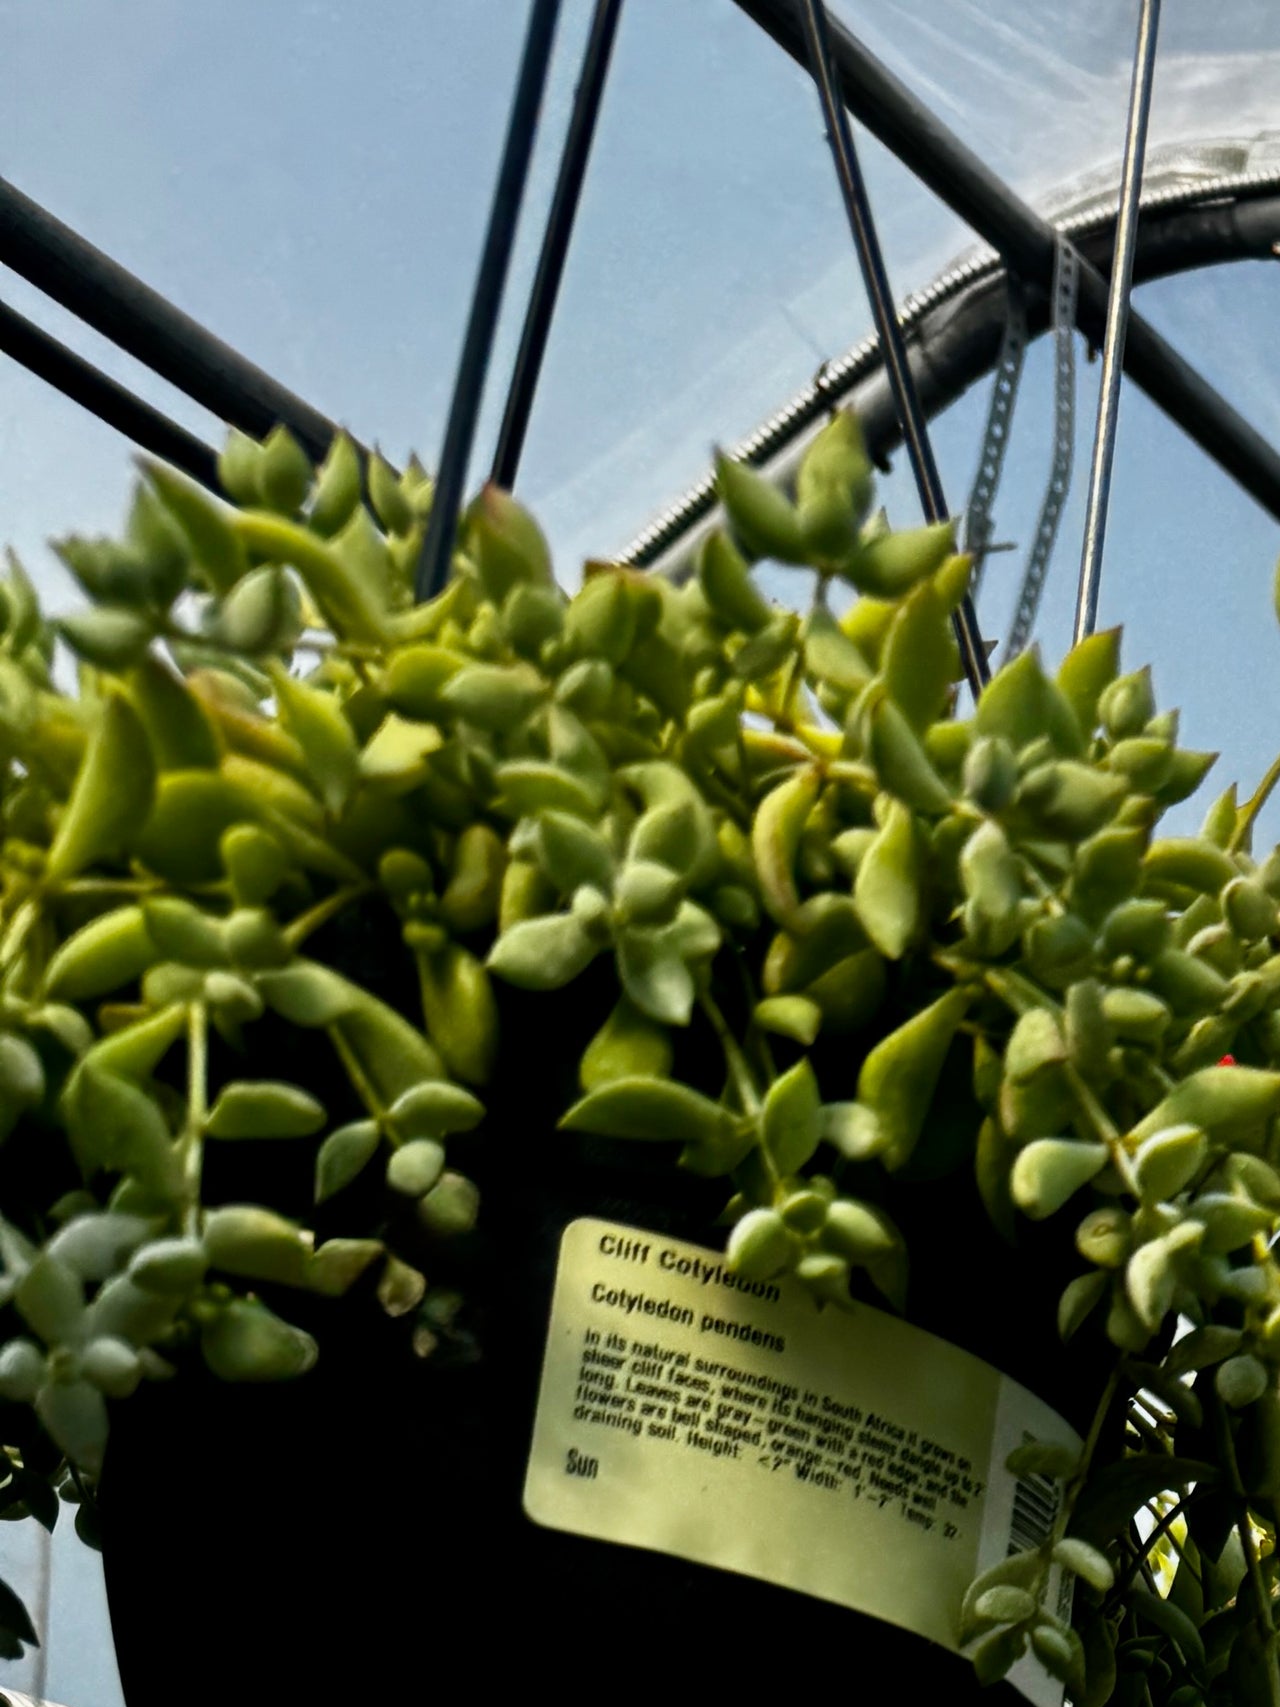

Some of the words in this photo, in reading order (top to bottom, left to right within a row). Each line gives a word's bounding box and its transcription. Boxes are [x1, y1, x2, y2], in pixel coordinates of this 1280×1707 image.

[599, 1234, 651, 1264] Cliff
[591, 1282, 694, 1325] Cotyledon
[701, 1314, 786, 1354] pendens
[582, 1349, 625, 1369] sheer
[632, 1361, 663, 1379] cliff
[668, 1368, 716, 1395] faces,
[720, 1384, 768, 1409] where
[772, 1397, 791, 1417] its
[796, 1406, 854, 1441] hanging
[585, 1328, 600, 1345] In
[606, 1331, 626, 1351] its
[632, 1341, 690, 1367] natural
[695, 1357, 799, 1401] surroundings
[803, 1390, 818, 1407] in
[822, 1396, 863, 1423] South
[573, 1404, 643, 1436] draining
[576, 1384, 636, 1412] flowers
[641, 1402, 668, 1420] are
[671, 1407, 700, 1427] bell
[705, 1418, 767, 1449] shaped,
[626, 1377, 681, 1403] Leaves
[685, 1395, 711, 1412] are
[814, 1434, 845, 1455] with
[565, 1447, 599, 1479] Sun
